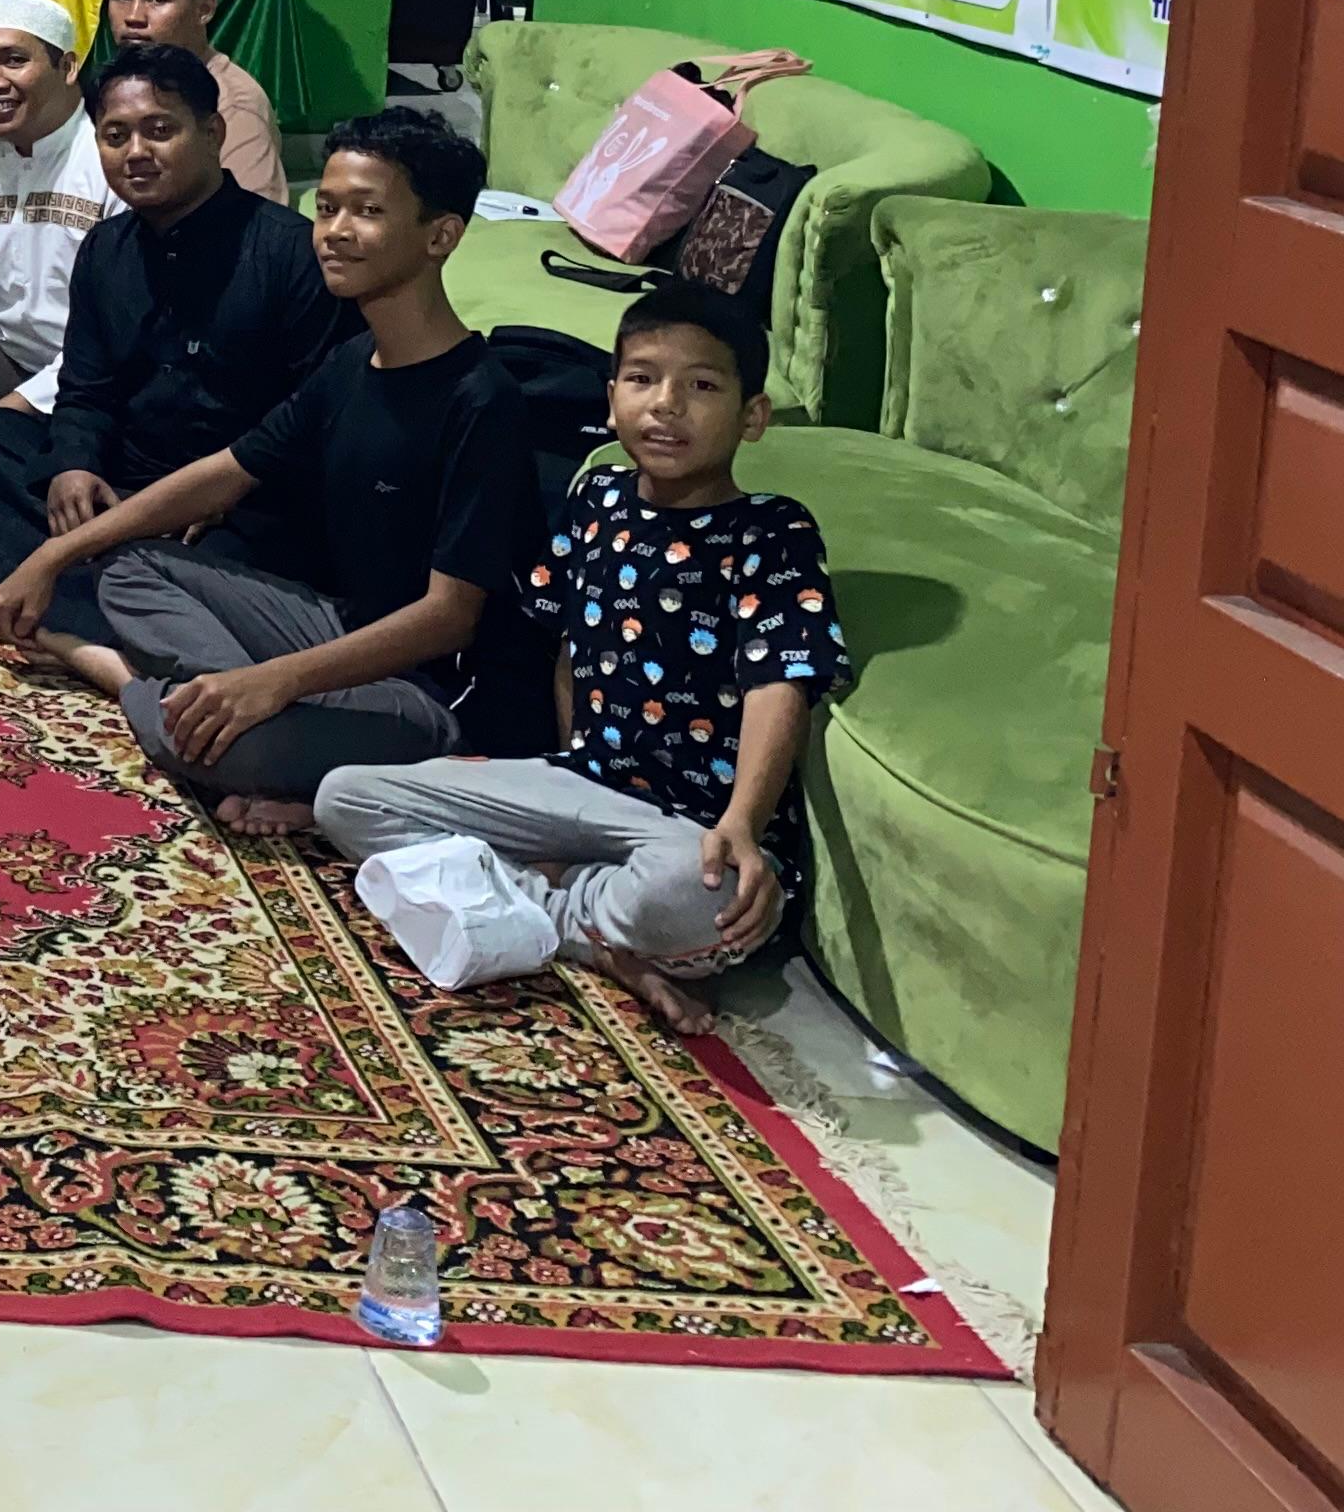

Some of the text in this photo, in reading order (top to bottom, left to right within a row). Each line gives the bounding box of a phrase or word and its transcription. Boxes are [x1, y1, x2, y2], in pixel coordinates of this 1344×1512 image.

[535, 598, 562, 614] STAY
[613, 597, 641, 610] COOL
[690, 610, 720, 629] STAY
[756, 612, 785, 634] STAY
[779, 649, 811, 662] STAY
[665, 691, 700, 706] COOL
